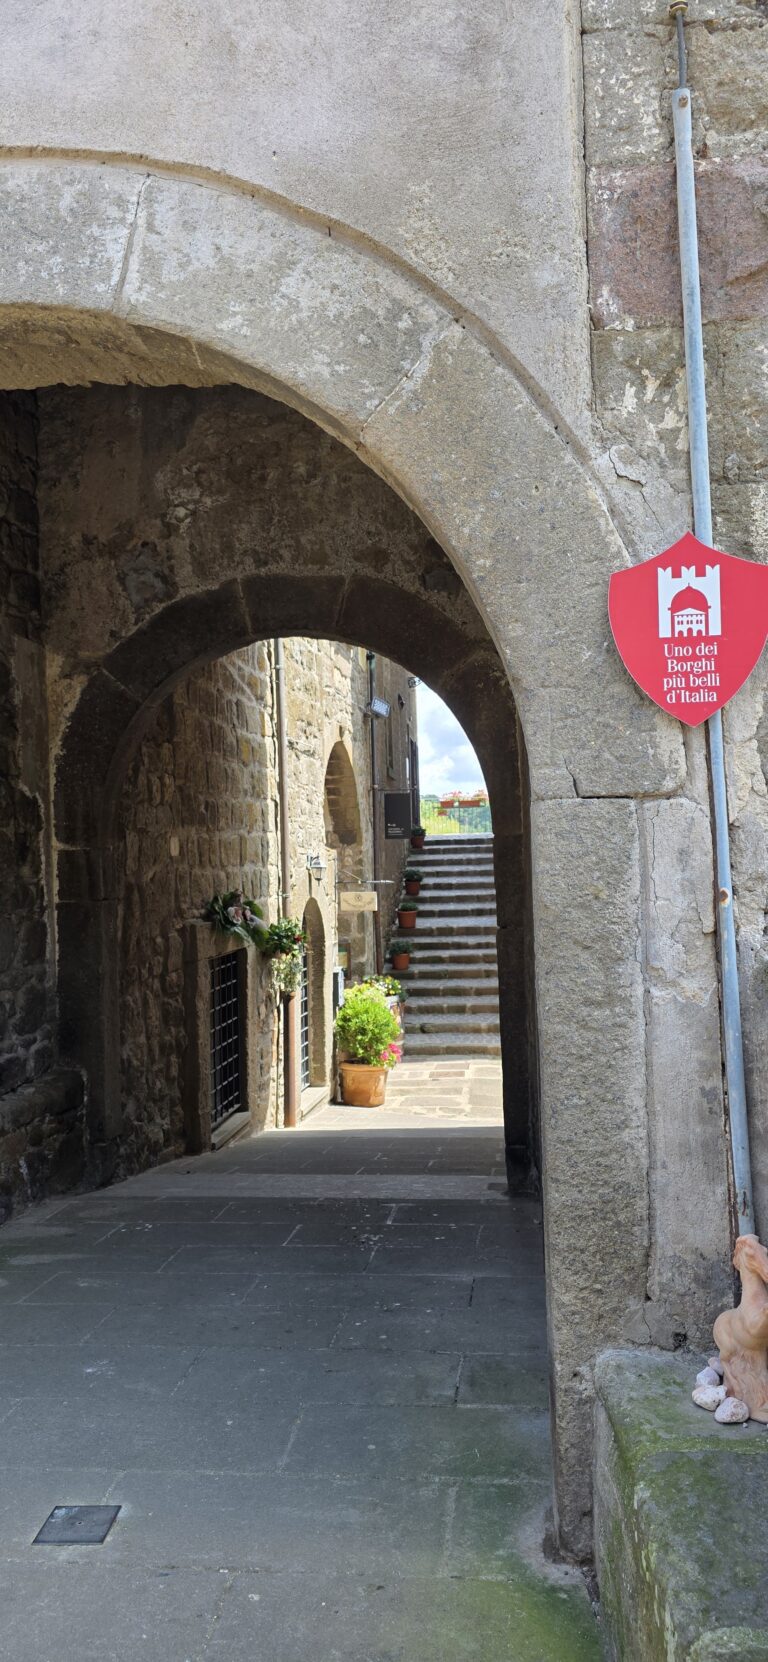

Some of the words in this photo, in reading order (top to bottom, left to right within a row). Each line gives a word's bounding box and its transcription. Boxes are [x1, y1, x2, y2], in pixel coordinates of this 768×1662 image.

[664, 643, 692, 657] Uno
[695, 642, 718, 656] dei
[667, 657, 715, 674] Borghi
[663, 674, 686, 691] più
[689, 672, 720, 687] belli
[666, 689, 717, 703] d'Italia
